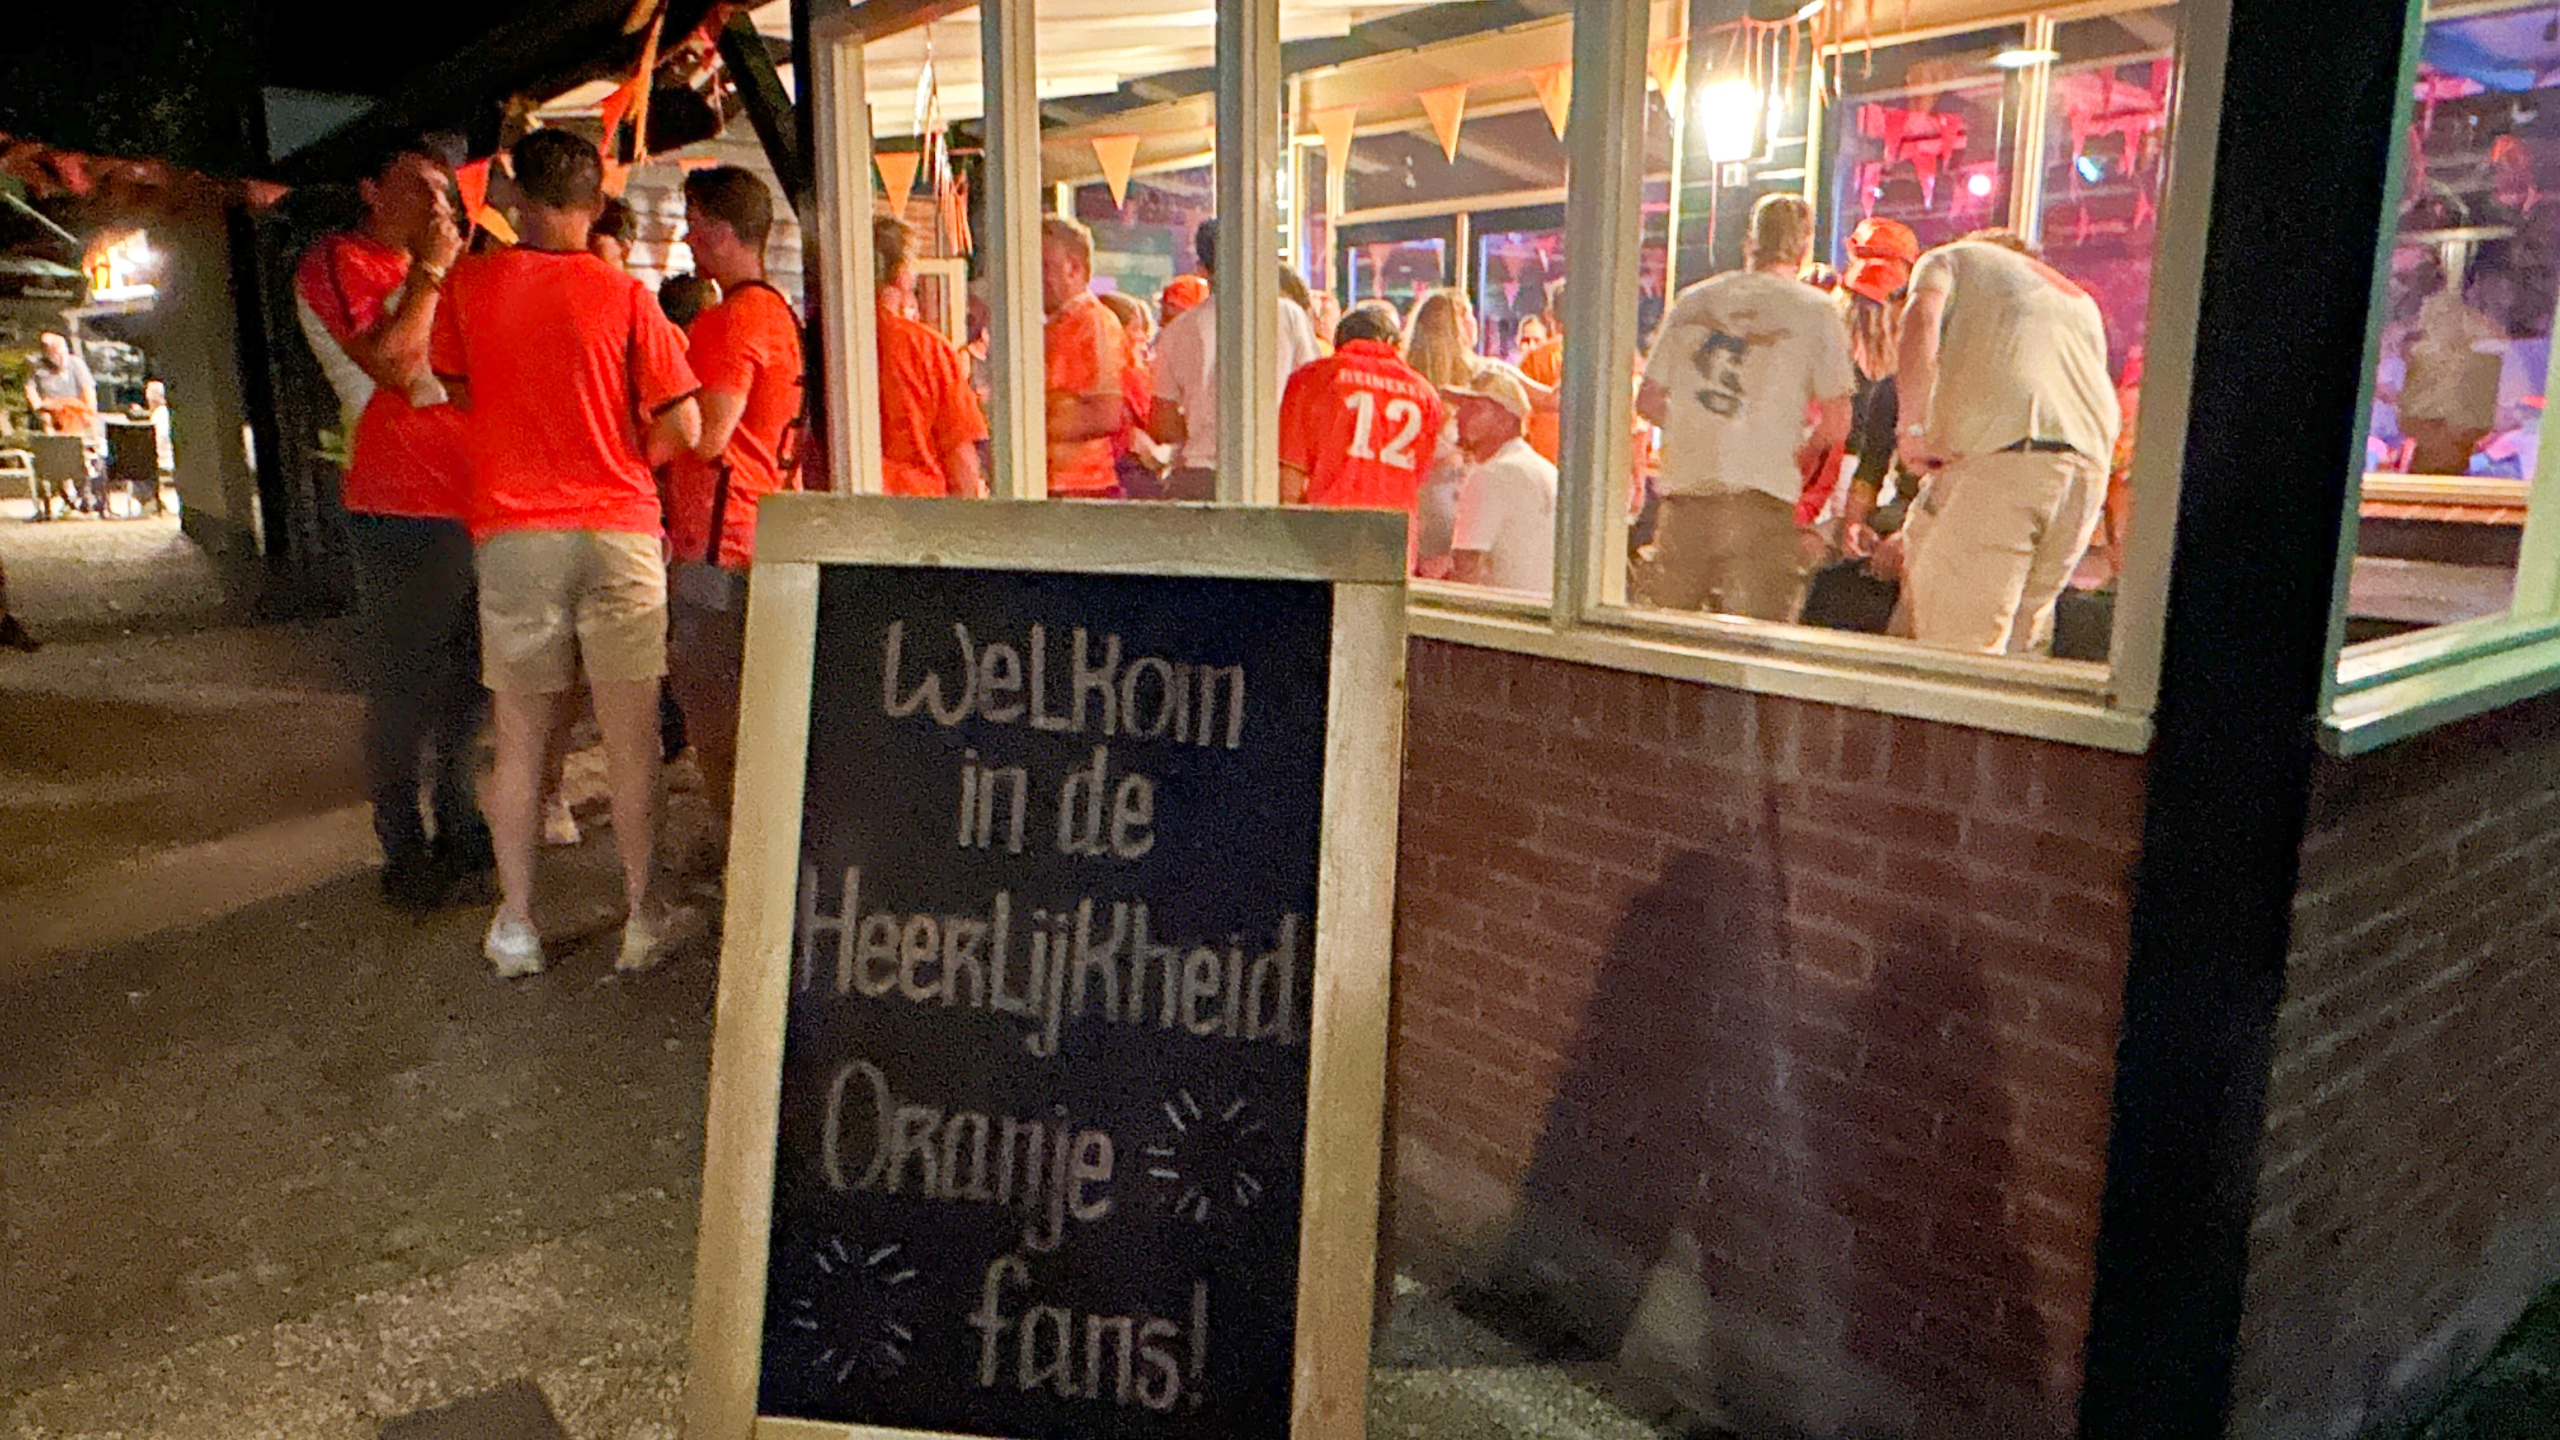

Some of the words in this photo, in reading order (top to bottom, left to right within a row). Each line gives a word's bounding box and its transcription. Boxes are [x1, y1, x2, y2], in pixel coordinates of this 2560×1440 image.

[1344, 390, 1423, 470] 12
[957, 749, 1027, 855] in
[1058, 744, 1156, 860] de
[966, 1253, 1209, 1411] fans!
